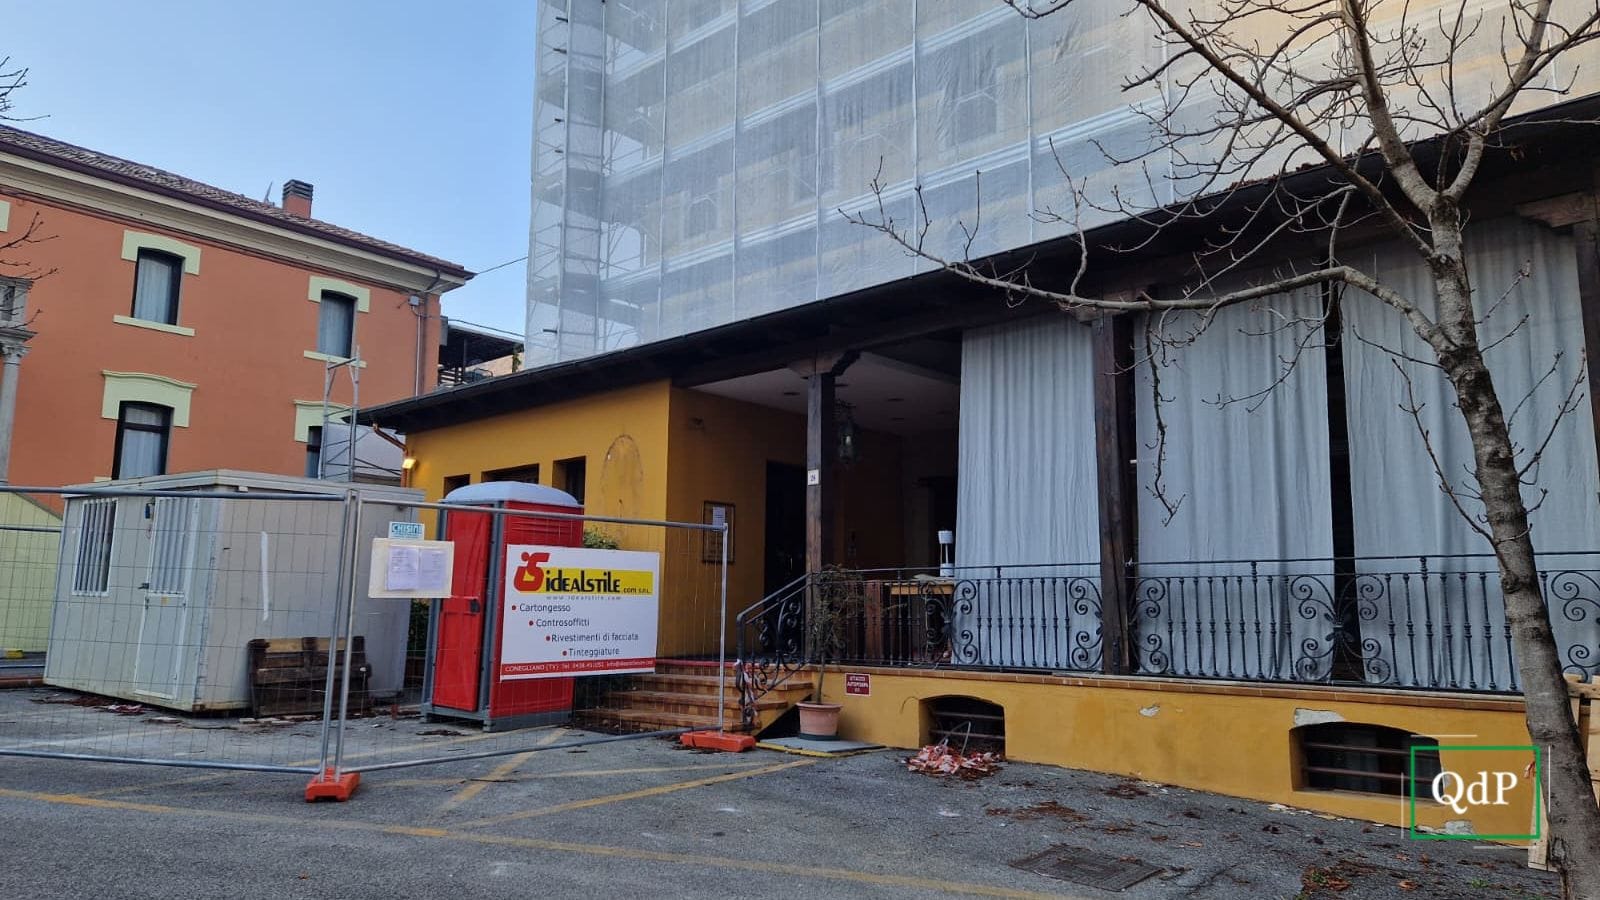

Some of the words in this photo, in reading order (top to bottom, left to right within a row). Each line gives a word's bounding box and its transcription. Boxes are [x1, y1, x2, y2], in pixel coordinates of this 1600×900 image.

[519, 603, 571, 613] Cartongesso
[535, 618, 590, 627] Controsoffitti
[551, 633, 601, 642] Rivestimenti
[602, 633, 610, 641] di
[611, 633, 639, 641] facciata
[568, 647, 620, 658] Tinteggiature
[504, 664, 545, 672] CONEGLIANO
